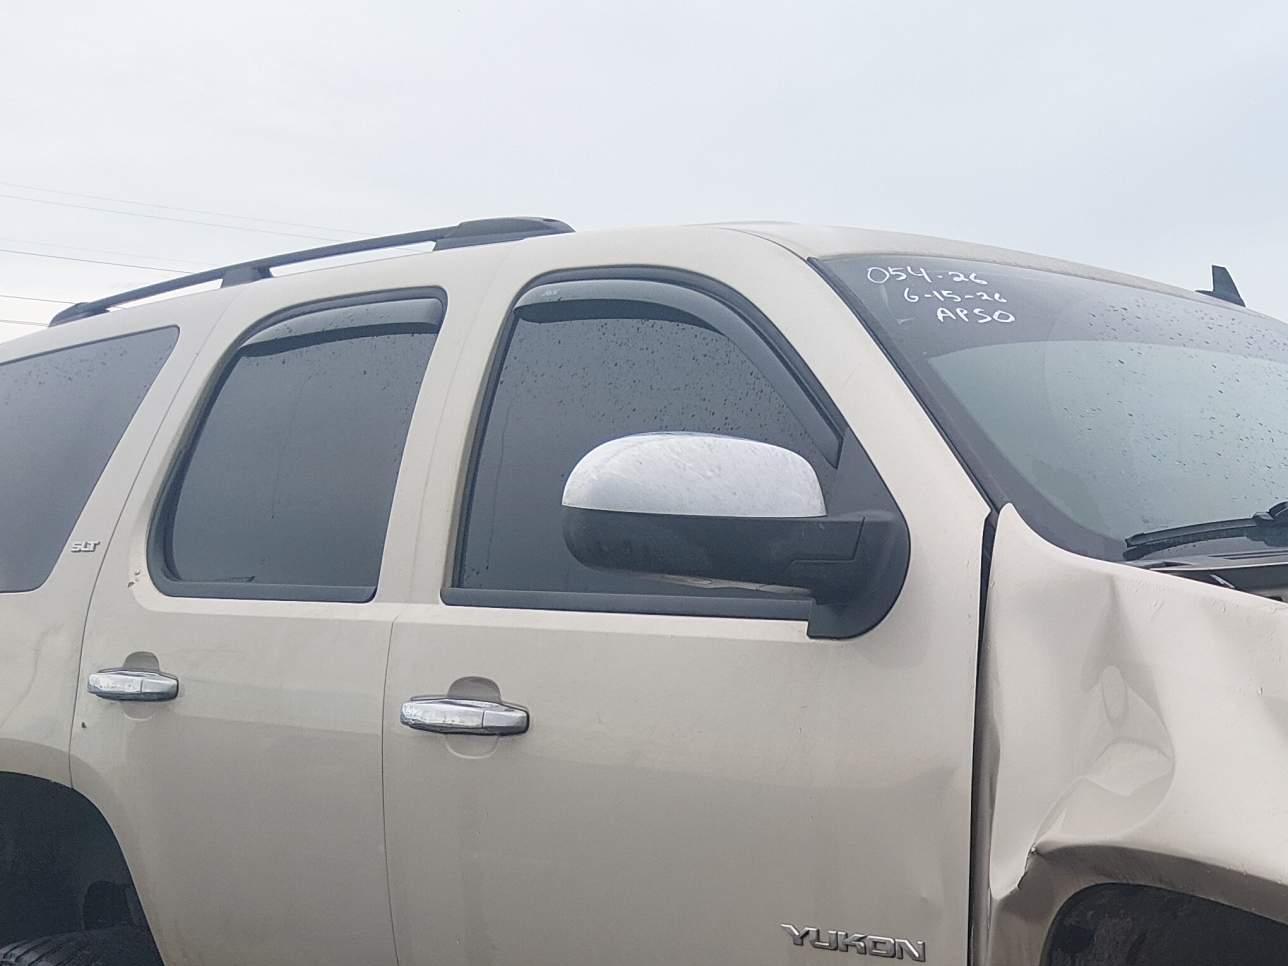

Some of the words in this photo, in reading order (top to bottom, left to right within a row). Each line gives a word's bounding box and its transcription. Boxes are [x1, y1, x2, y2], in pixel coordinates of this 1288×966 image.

[867, 265, 988, 285] 054-26
[903, 287, 1008, 303] 6-15-26
[71, 541, 101, 553] SLT
[780, 923, 926, 962] YUKON
